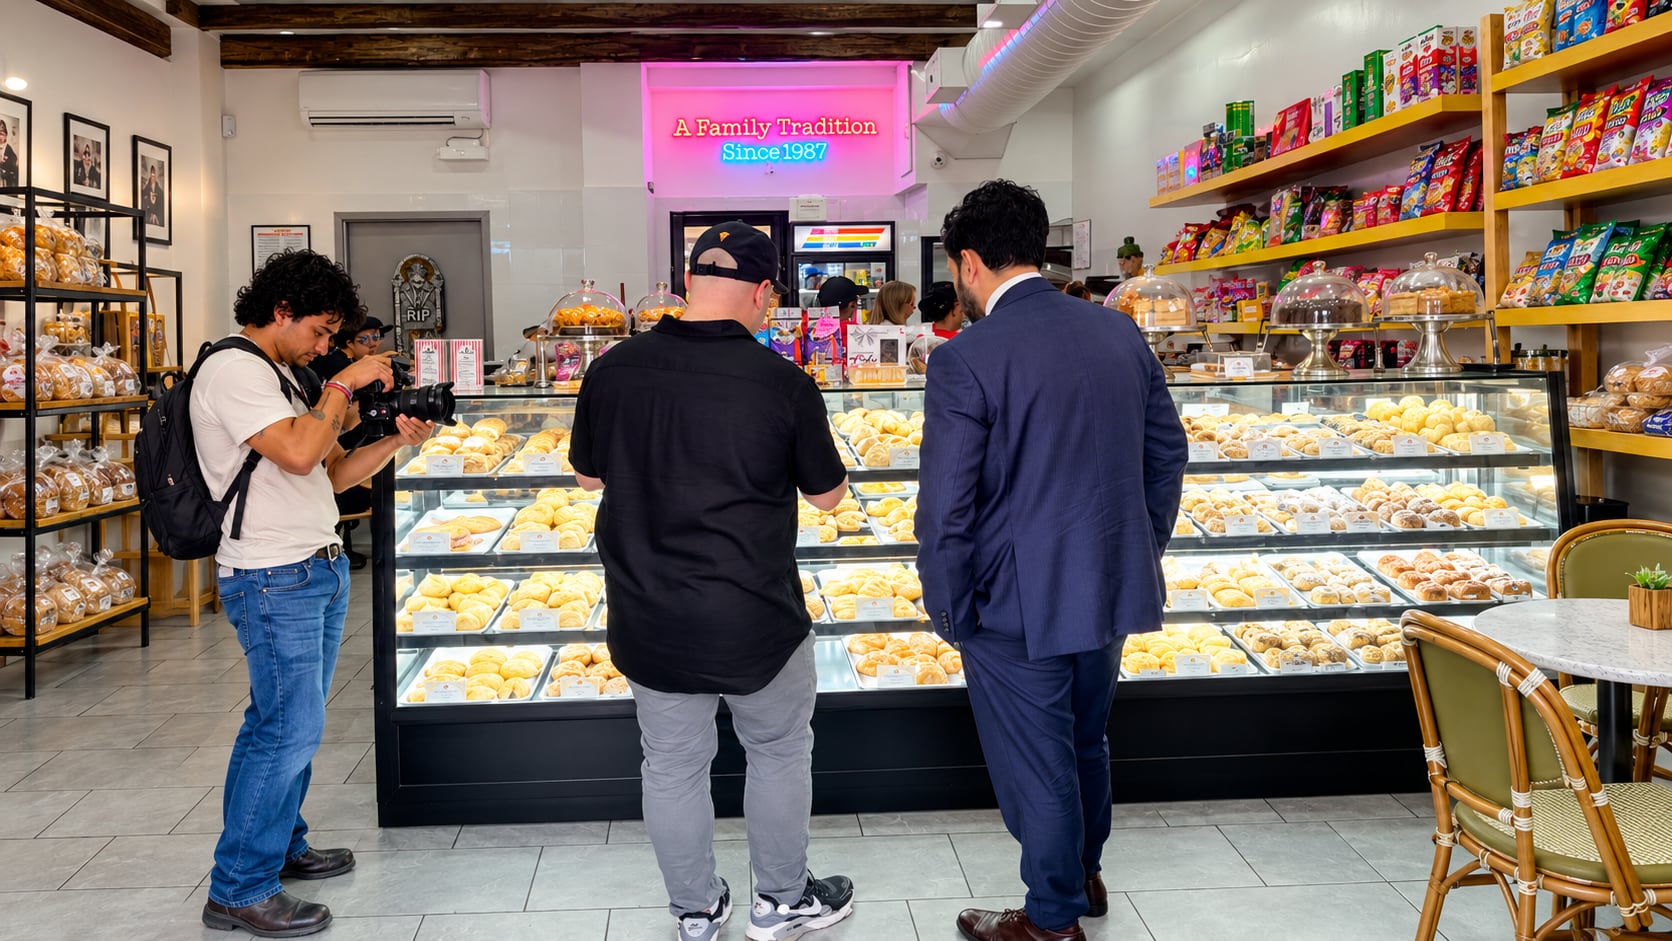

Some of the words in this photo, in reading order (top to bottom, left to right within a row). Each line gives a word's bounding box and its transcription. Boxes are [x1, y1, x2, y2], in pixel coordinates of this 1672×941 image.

[673, 119, 691, 137] A
[696, 118, 771, 139] Family
[777, 117, 877, 135] Tradition
[722, 143, 780, 161] Since
[783, 142, 828, 160] 1987
[407, 309, 430, 321] RIP
